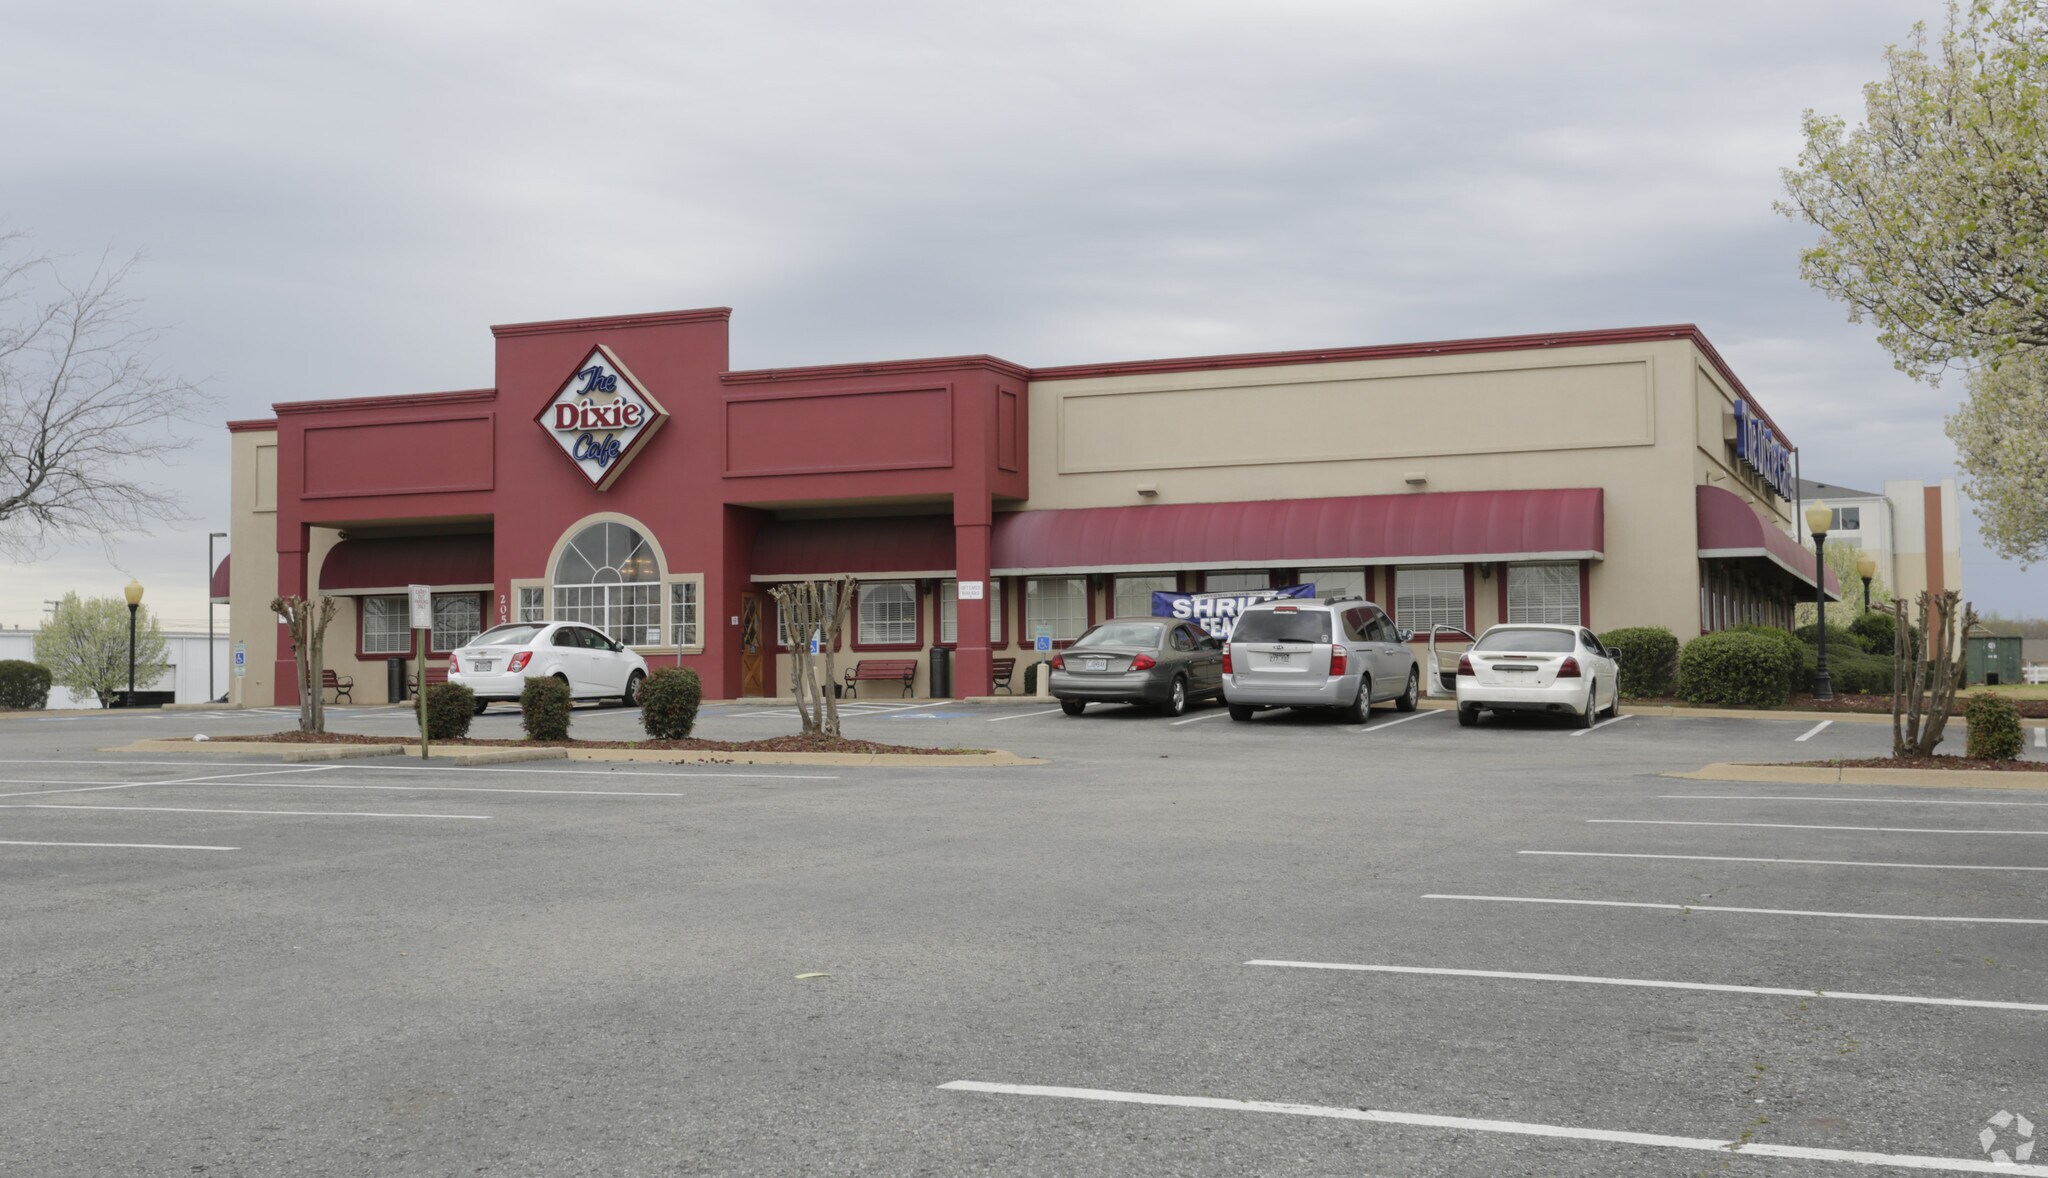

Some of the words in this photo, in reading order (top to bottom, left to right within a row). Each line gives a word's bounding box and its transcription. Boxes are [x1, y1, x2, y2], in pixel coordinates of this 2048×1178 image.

[577, 366, 617, 395] The
[554, 397, 644, 431] Dixie
[572, 432, 621, 467] Cafe
[1172, 594, 1290, 620] SHRI
